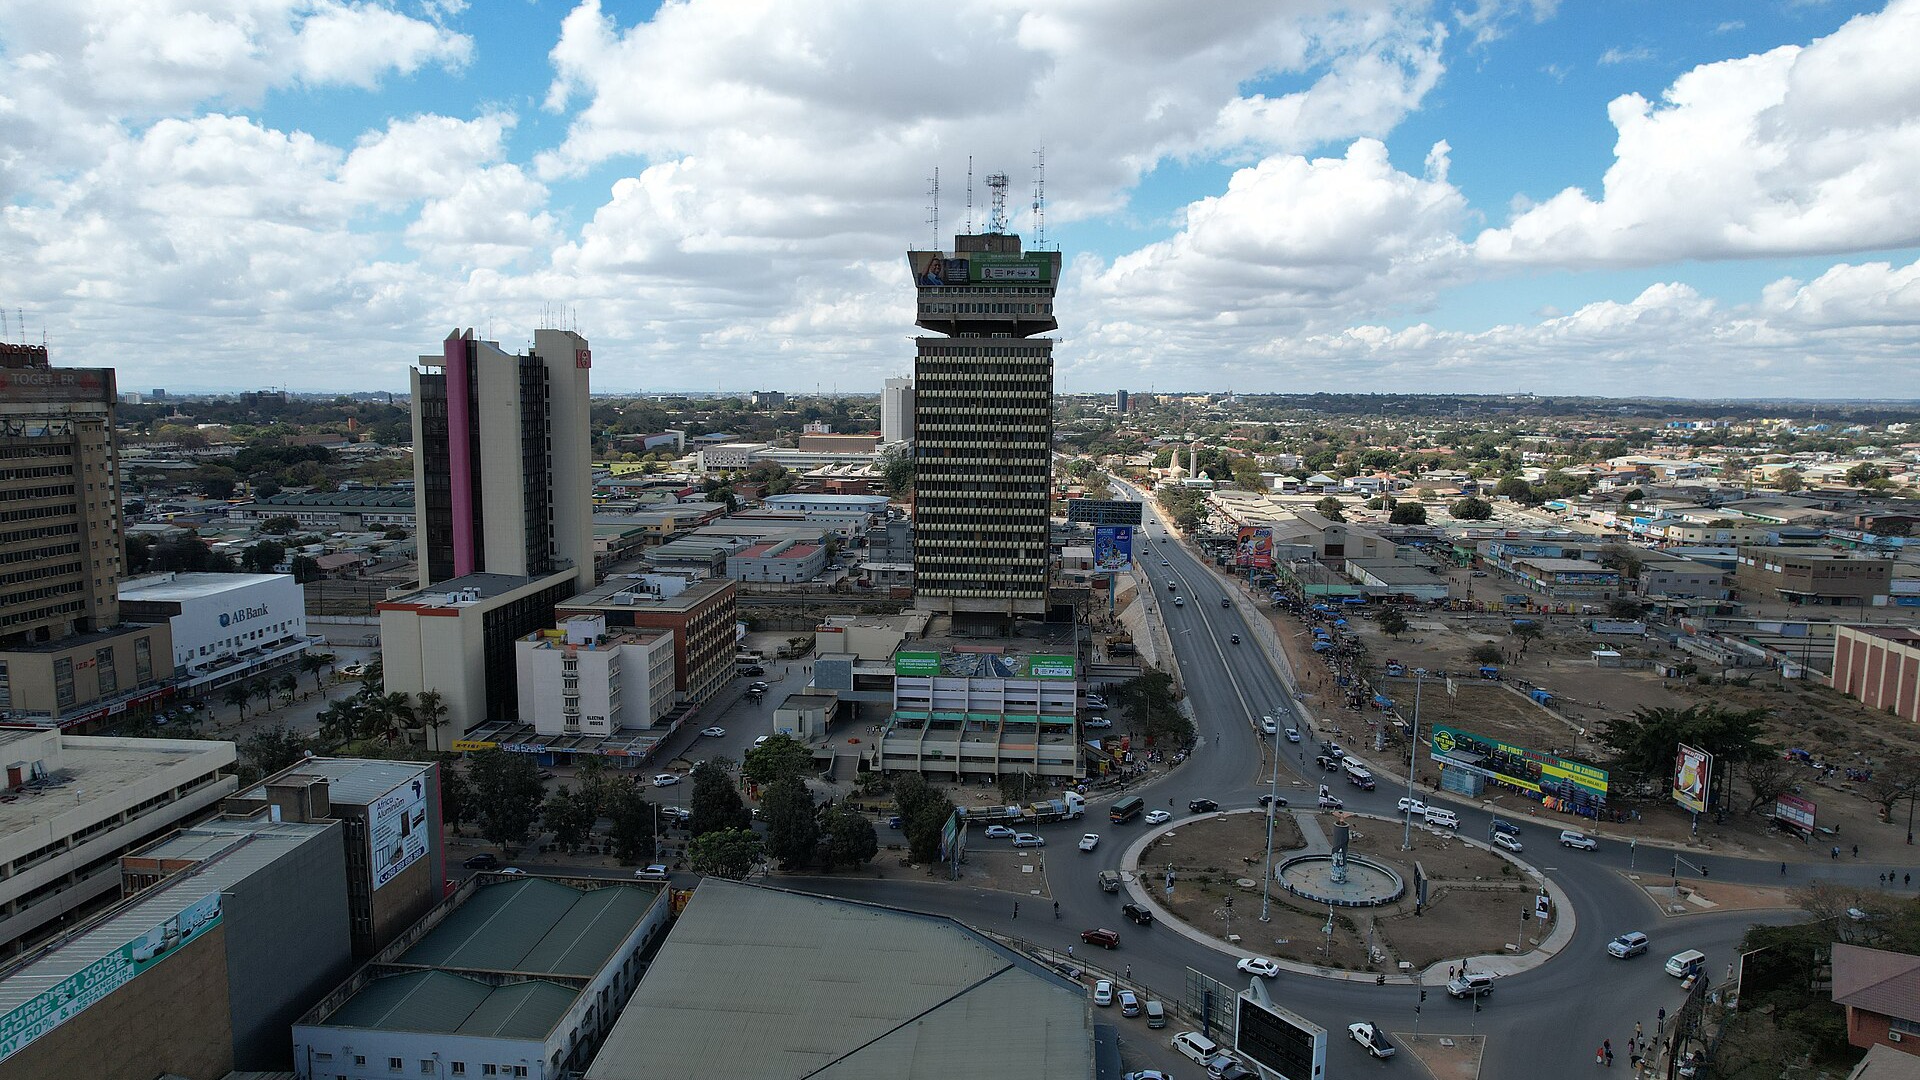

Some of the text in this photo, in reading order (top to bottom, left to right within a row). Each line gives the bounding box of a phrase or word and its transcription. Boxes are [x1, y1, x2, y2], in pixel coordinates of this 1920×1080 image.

[0, 341, 46, 356] NDECO
[231, 602, 270, 625] AB Bank
[75, 661, 88, 671] IZB
[1497, 743, 1507, 752] THE
[1508, 746, 1523, 756] FIRST
[1574, 764, 1580, 772] IN
[1581, 766, 1604, 779] ZAMBIA
[376, 796, 394, 811] Africa
[0, 950, 124, 1029] FURNISH YOUR
[0, 959, 127, 1039] HOME & LODGE
[71, 971, 134, 1014] INSTALMENTS
[77, 967, 128, 1003] BALANCE IN
[0, 1007, 69, 1058] AY 50% &
